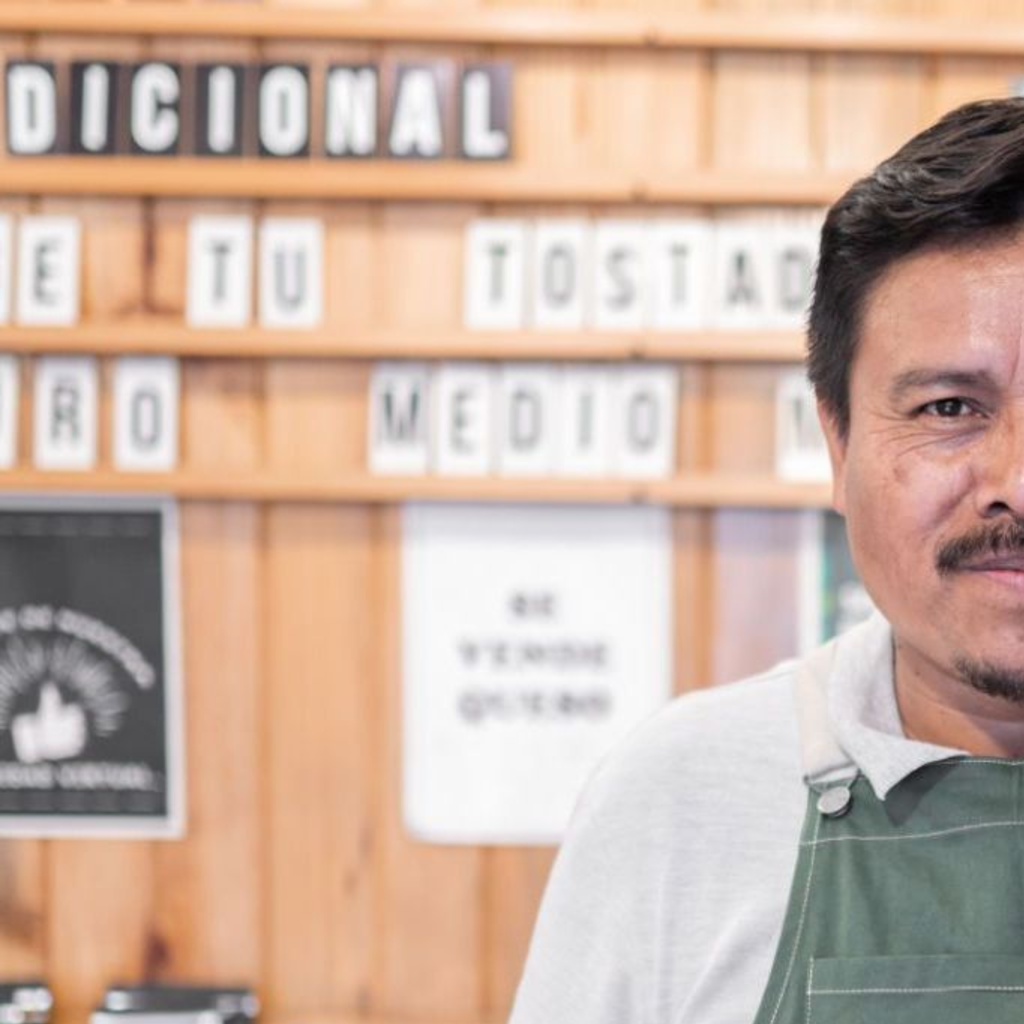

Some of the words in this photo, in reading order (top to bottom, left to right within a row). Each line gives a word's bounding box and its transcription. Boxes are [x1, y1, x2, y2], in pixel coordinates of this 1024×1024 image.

[6, 63, 508, 156] DICIONAL
[209, 242, 307, 312] TU
[0, 382, 162, 450] RO
[381, 387, 660, 451] MEDIO
